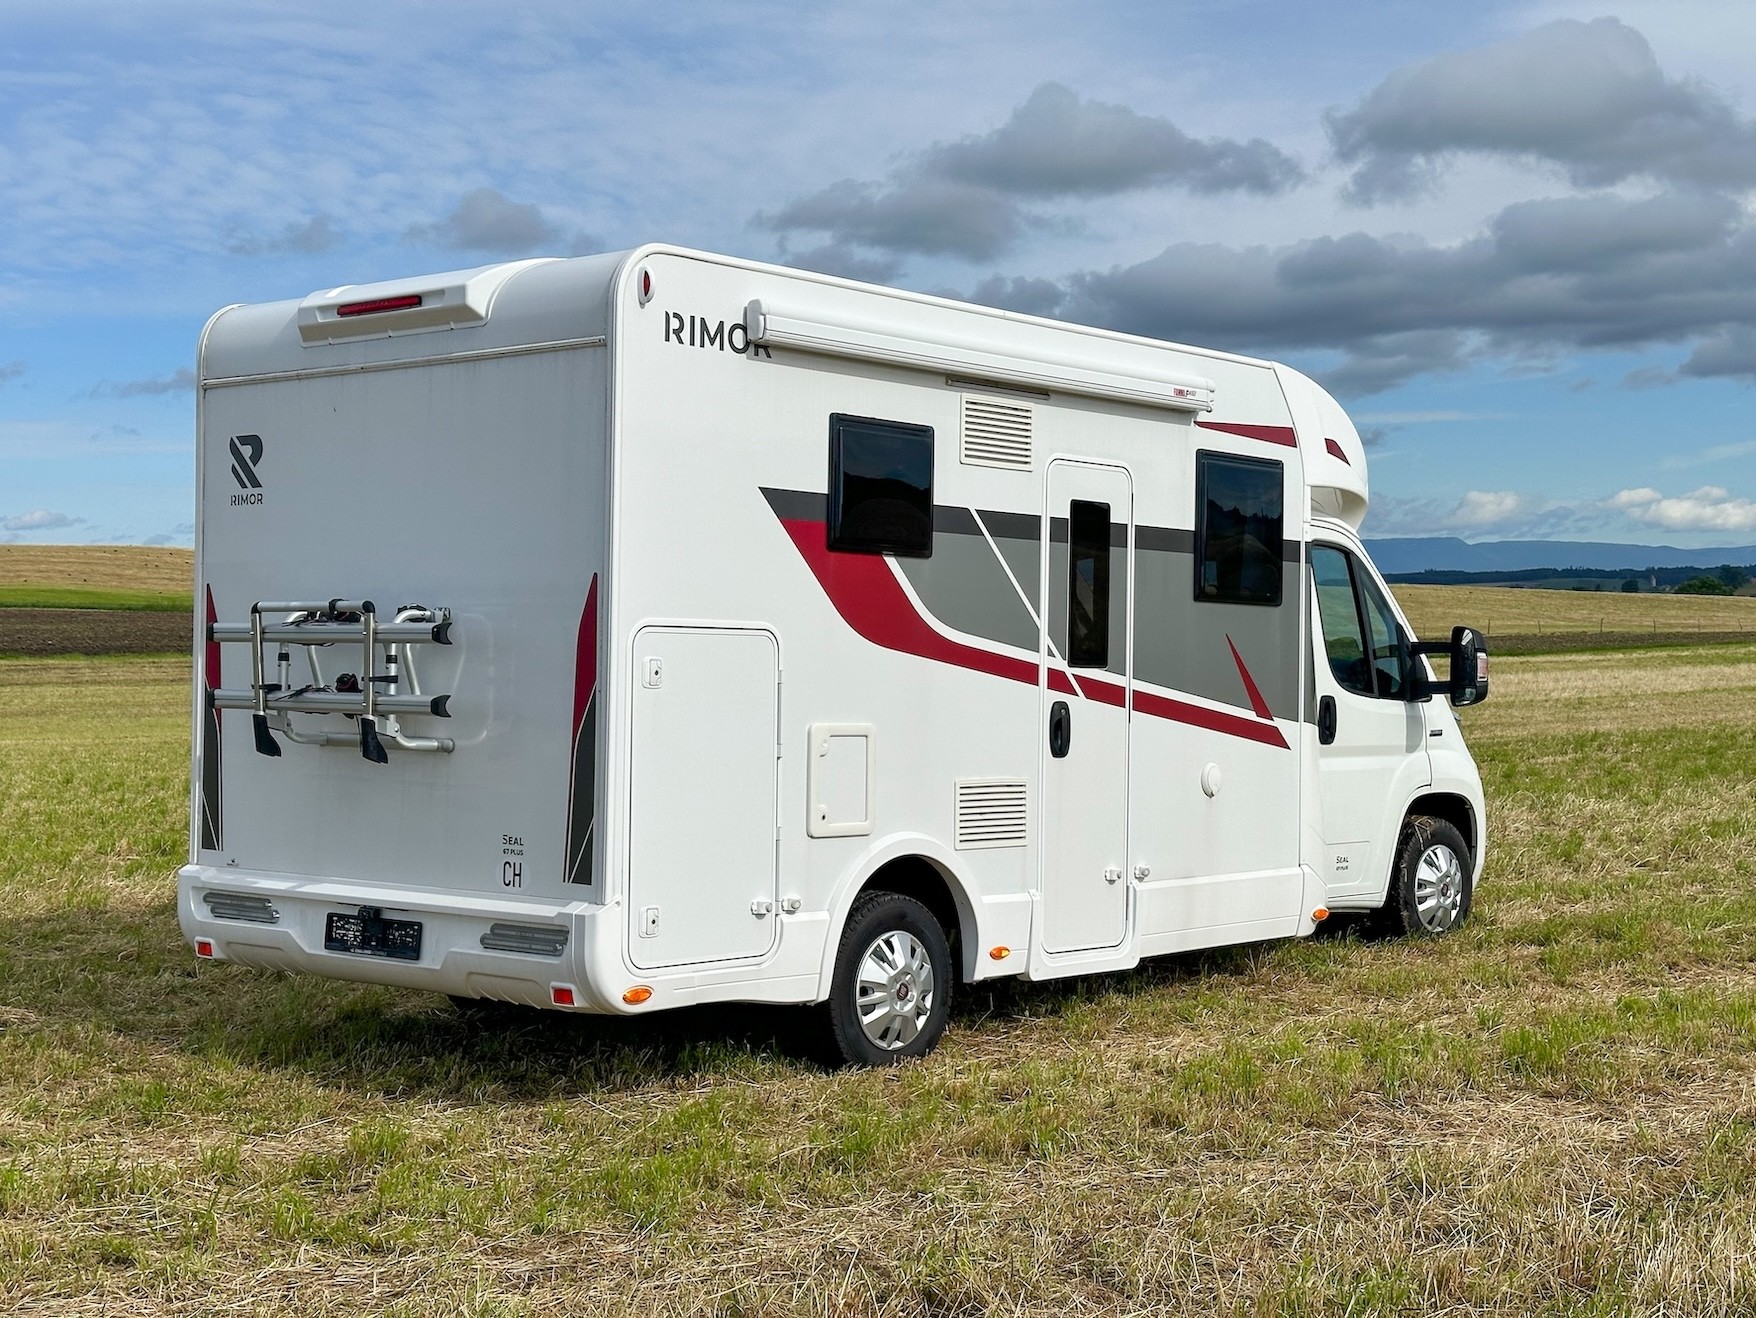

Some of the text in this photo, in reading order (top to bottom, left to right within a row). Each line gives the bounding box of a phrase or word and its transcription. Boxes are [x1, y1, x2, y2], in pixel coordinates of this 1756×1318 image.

[230, 493, 263, 506] RIMOR
[502, 834, 524, 846] SEAL
[503, 861, 522, 888] CH
